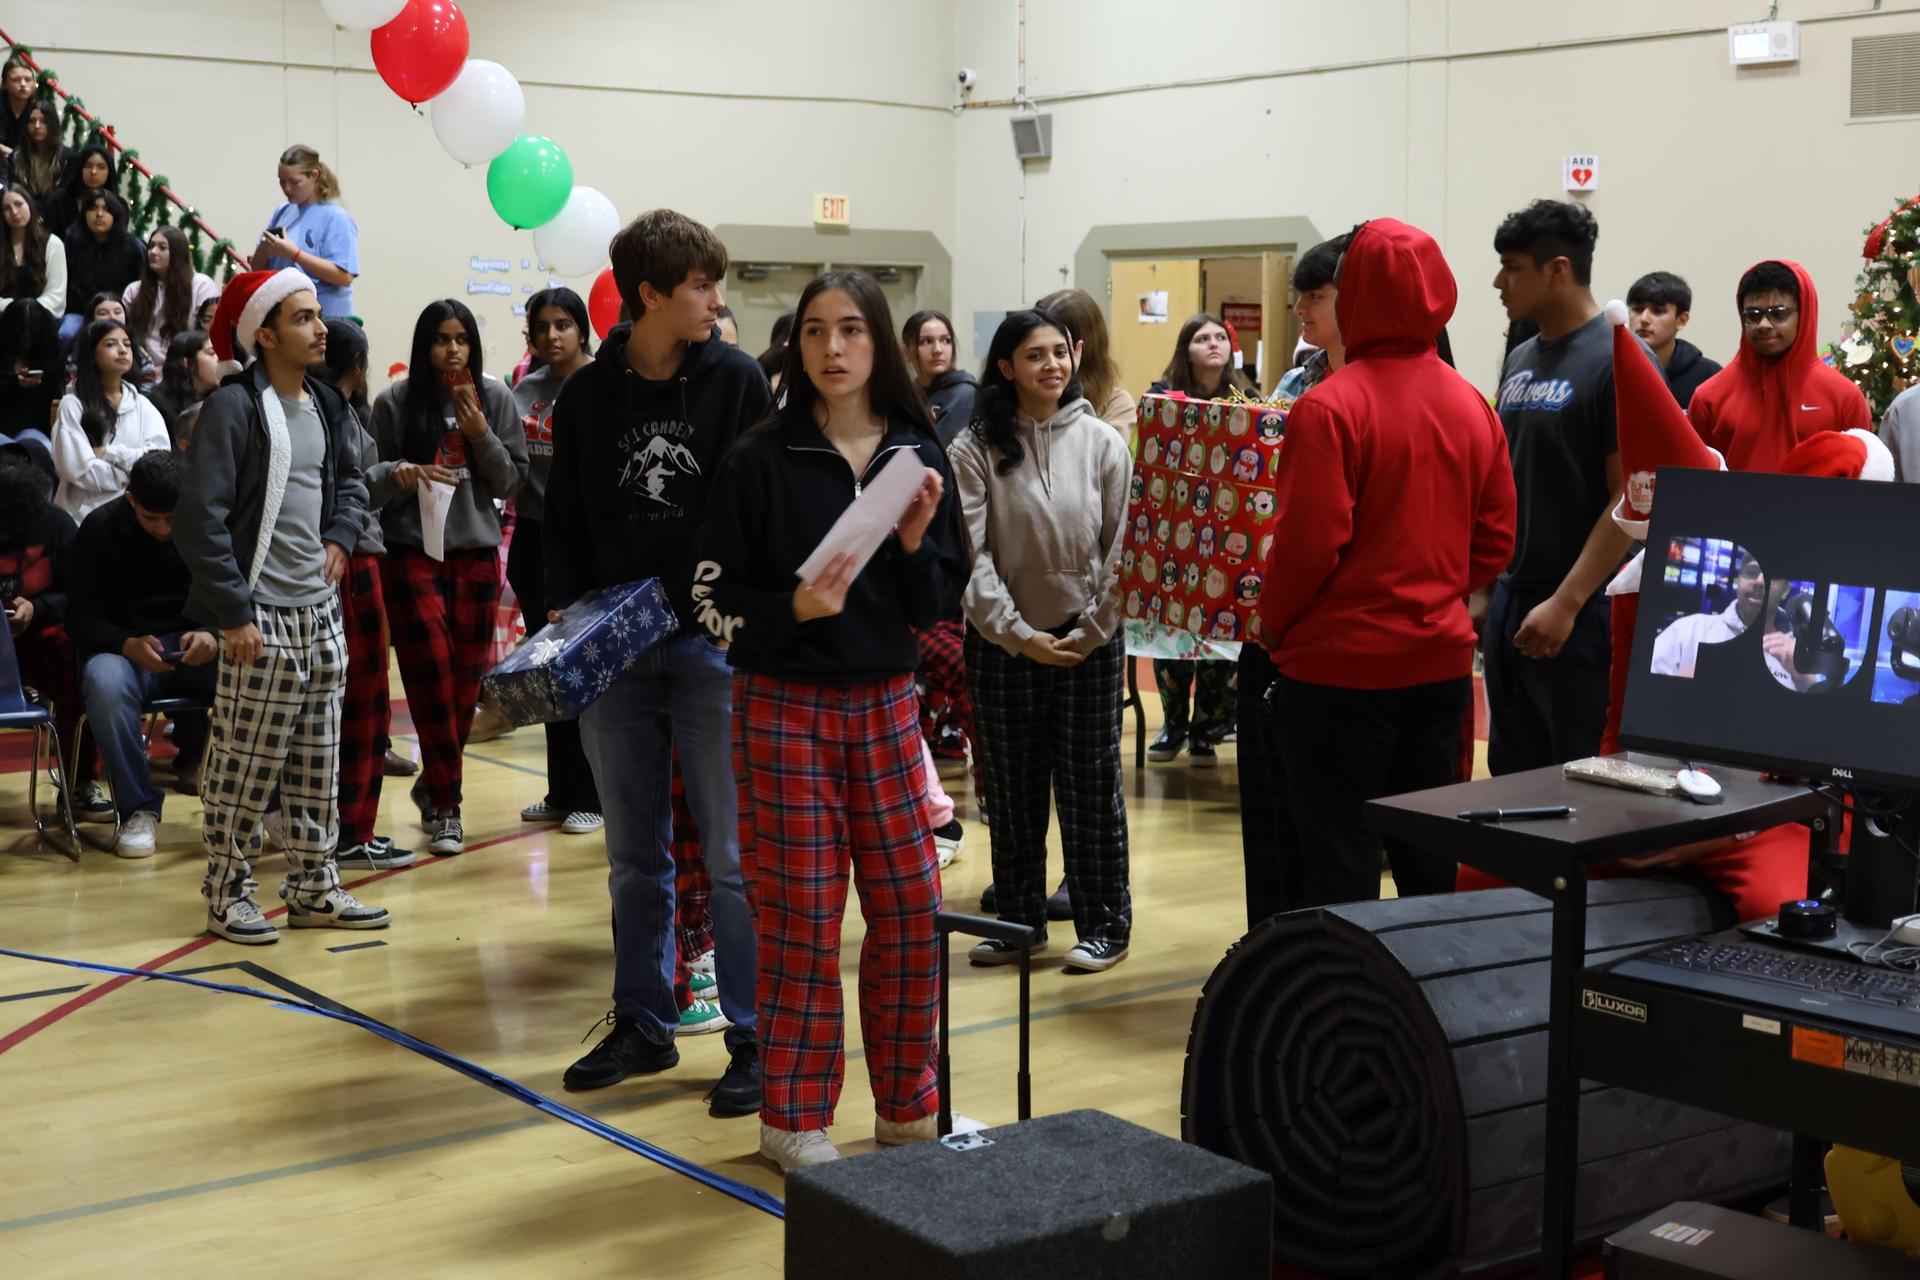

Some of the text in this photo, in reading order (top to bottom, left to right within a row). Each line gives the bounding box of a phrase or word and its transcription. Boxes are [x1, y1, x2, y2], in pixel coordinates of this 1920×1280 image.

[1572, 157, 1594, 165] AED
[823, 198, 845, 219] EXIT
[1500, 369, 1574, 411] Flavors
[1832, 768, 1853, 779] DELL
[1598, 997, 1645, 1017] LUXOR
